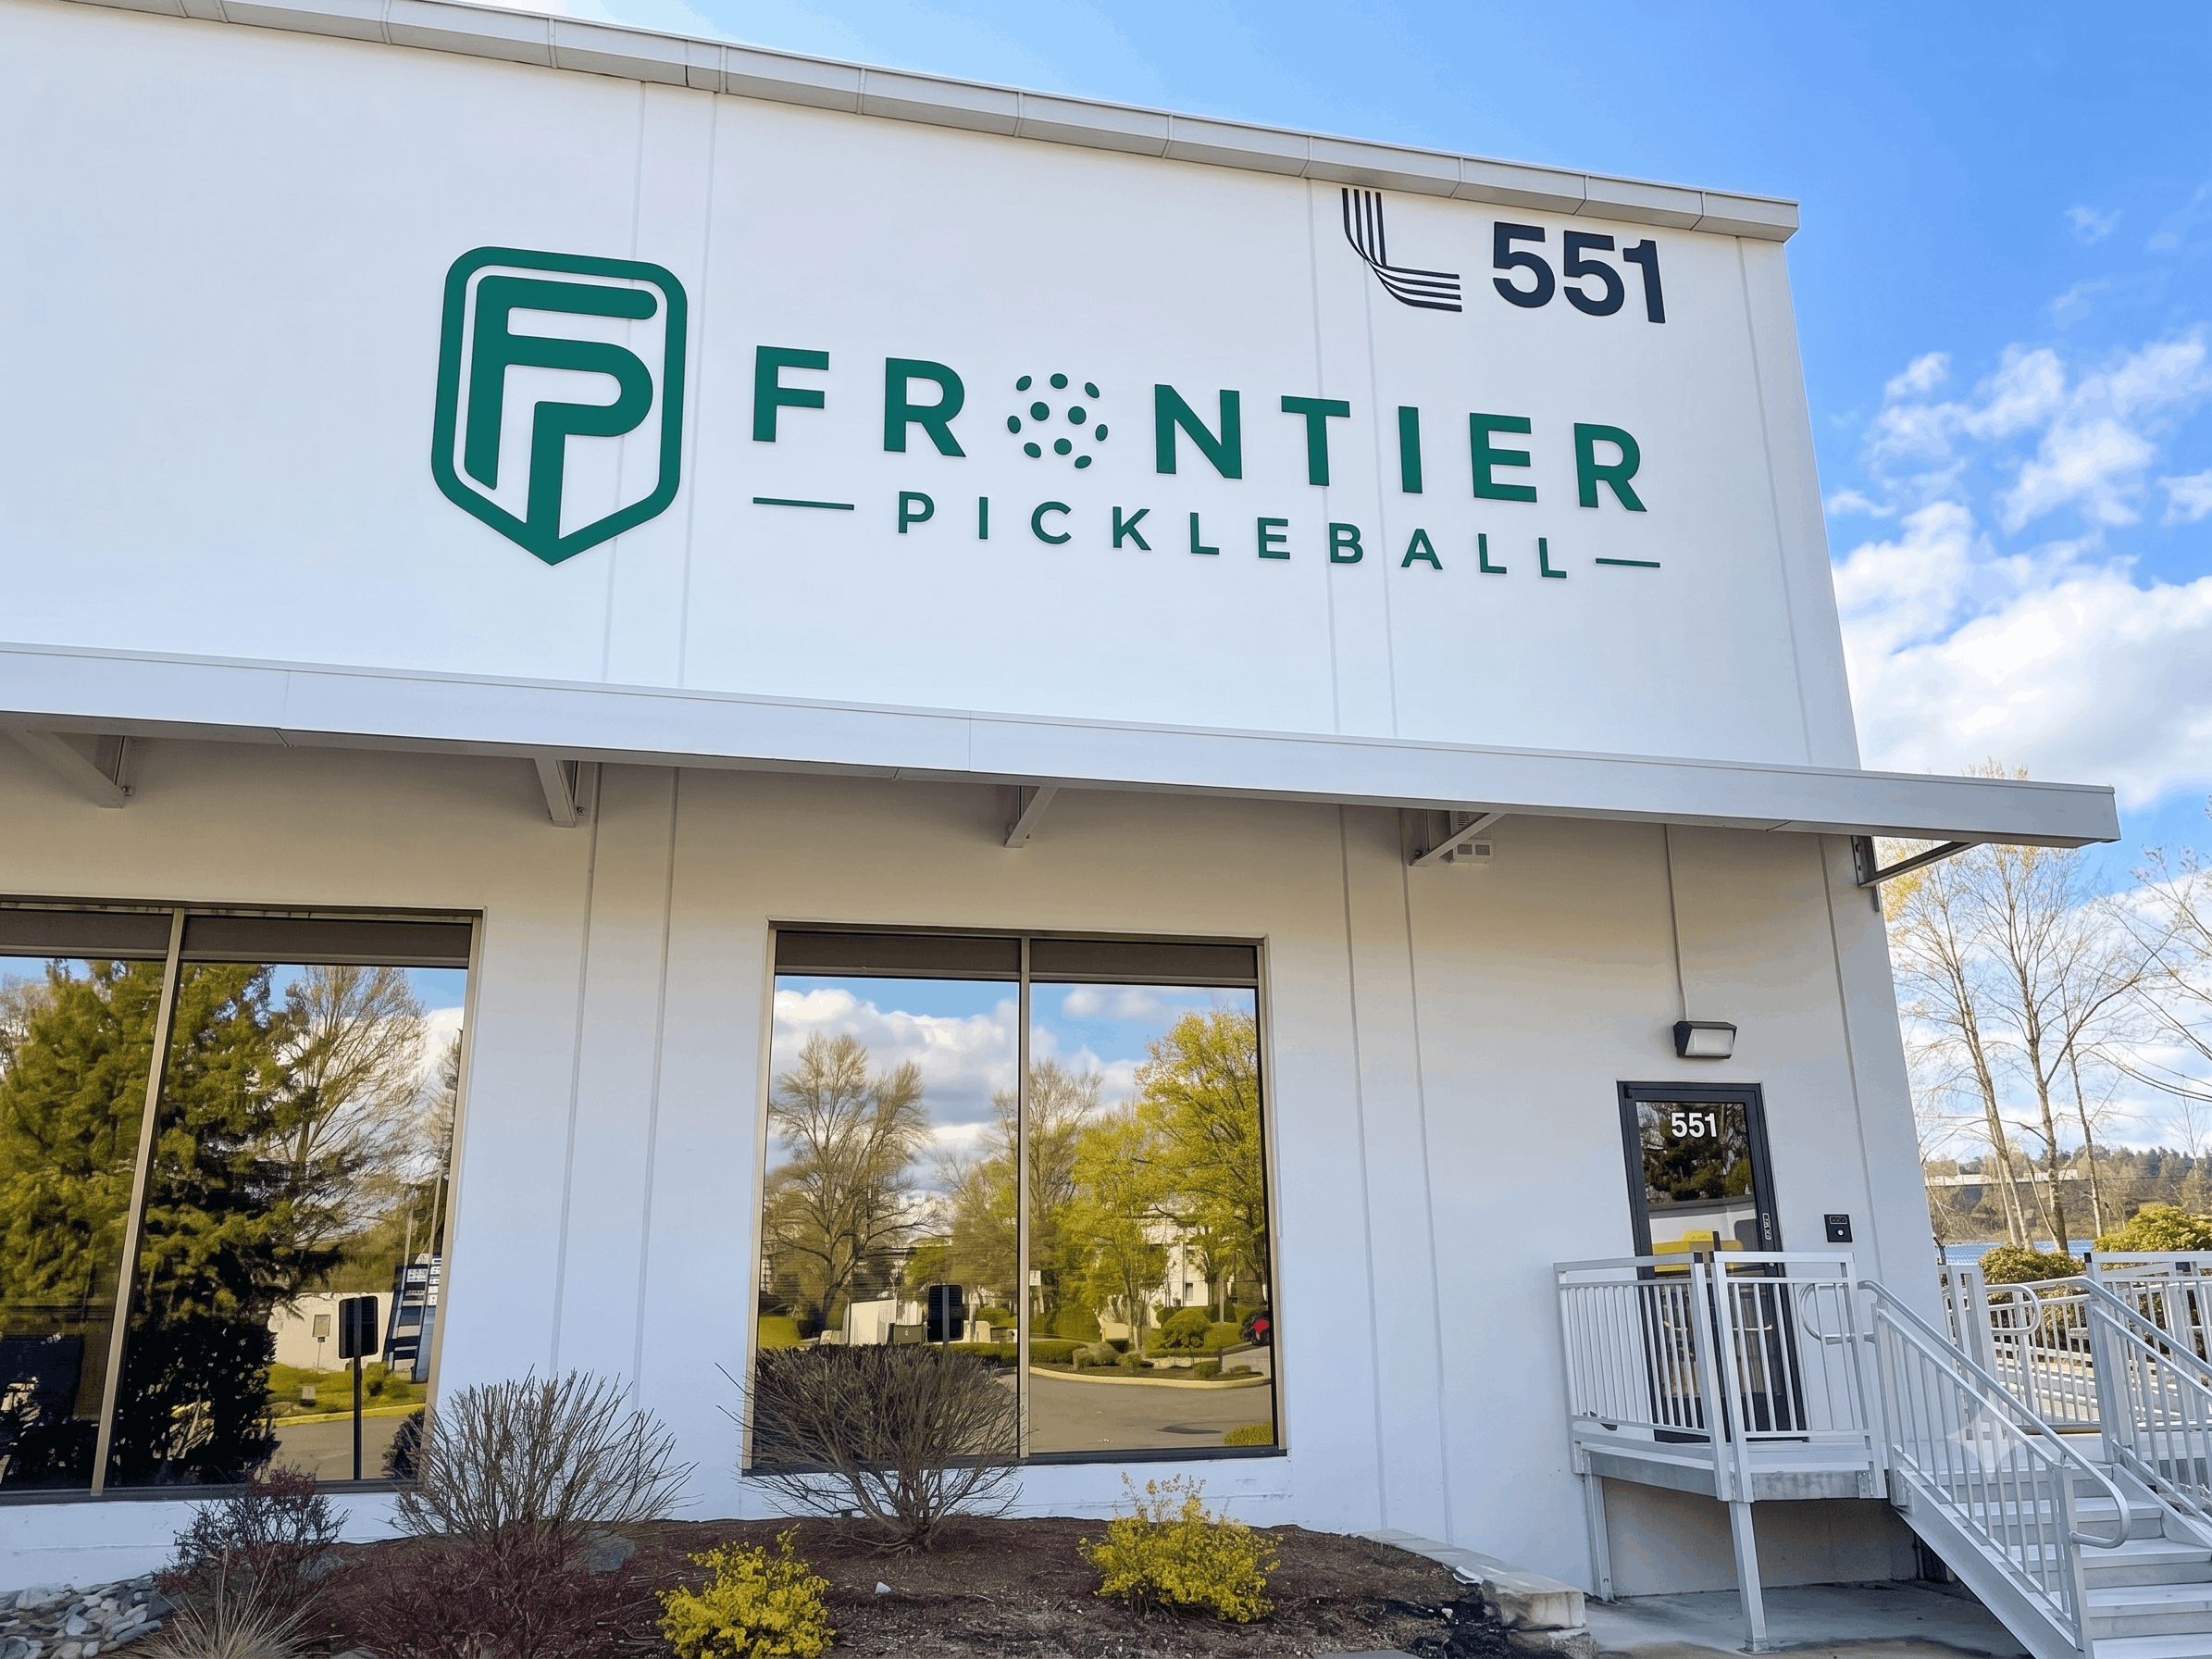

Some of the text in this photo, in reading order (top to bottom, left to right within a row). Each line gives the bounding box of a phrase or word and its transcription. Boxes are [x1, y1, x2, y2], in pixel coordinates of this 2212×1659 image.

[1492, 220, 1667, 325] 551
[898, 491, 1568, 580] PICKLEBALL
[1671, 1112, 1718, 1139] 551
